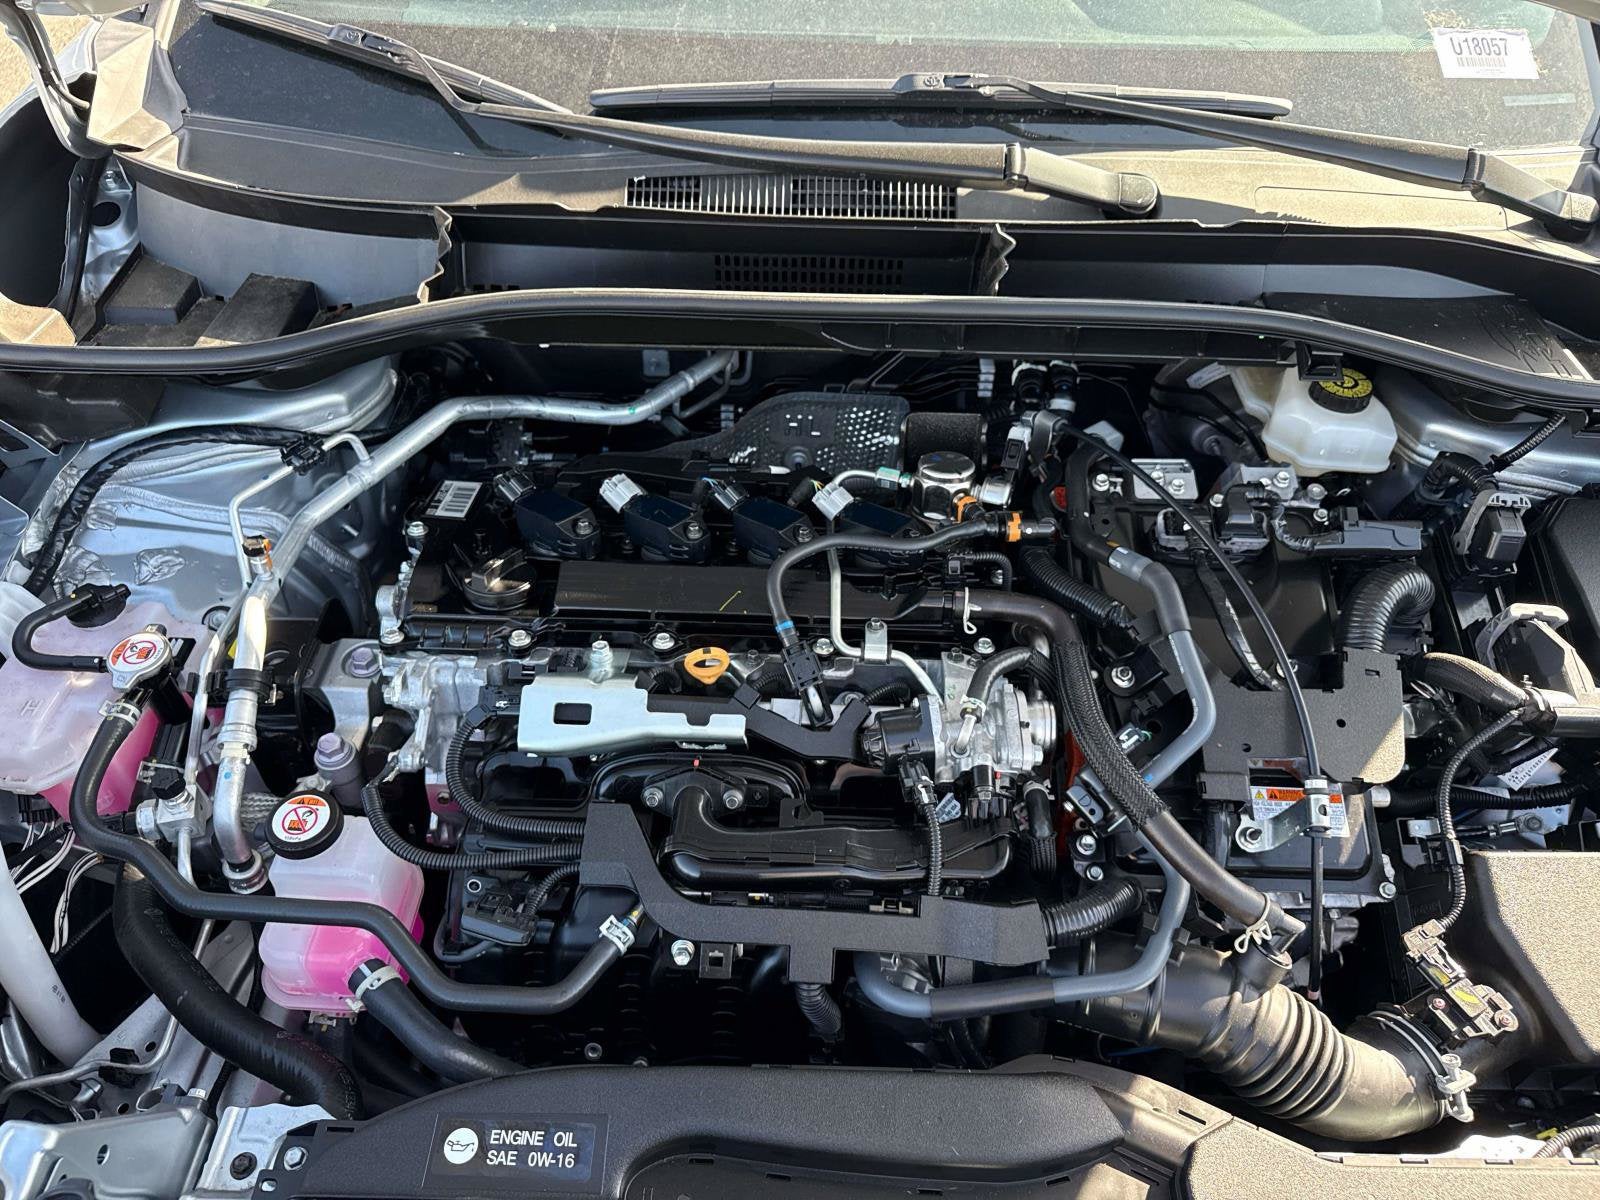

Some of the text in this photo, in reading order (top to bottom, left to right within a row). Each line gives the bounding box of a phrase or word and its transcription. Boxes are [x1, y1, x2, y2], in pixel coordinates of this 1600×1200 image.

[490, 1129, 577, 1147] ENGINE OIL
[486, 1150, 575, 1168] SAE 0W-16
